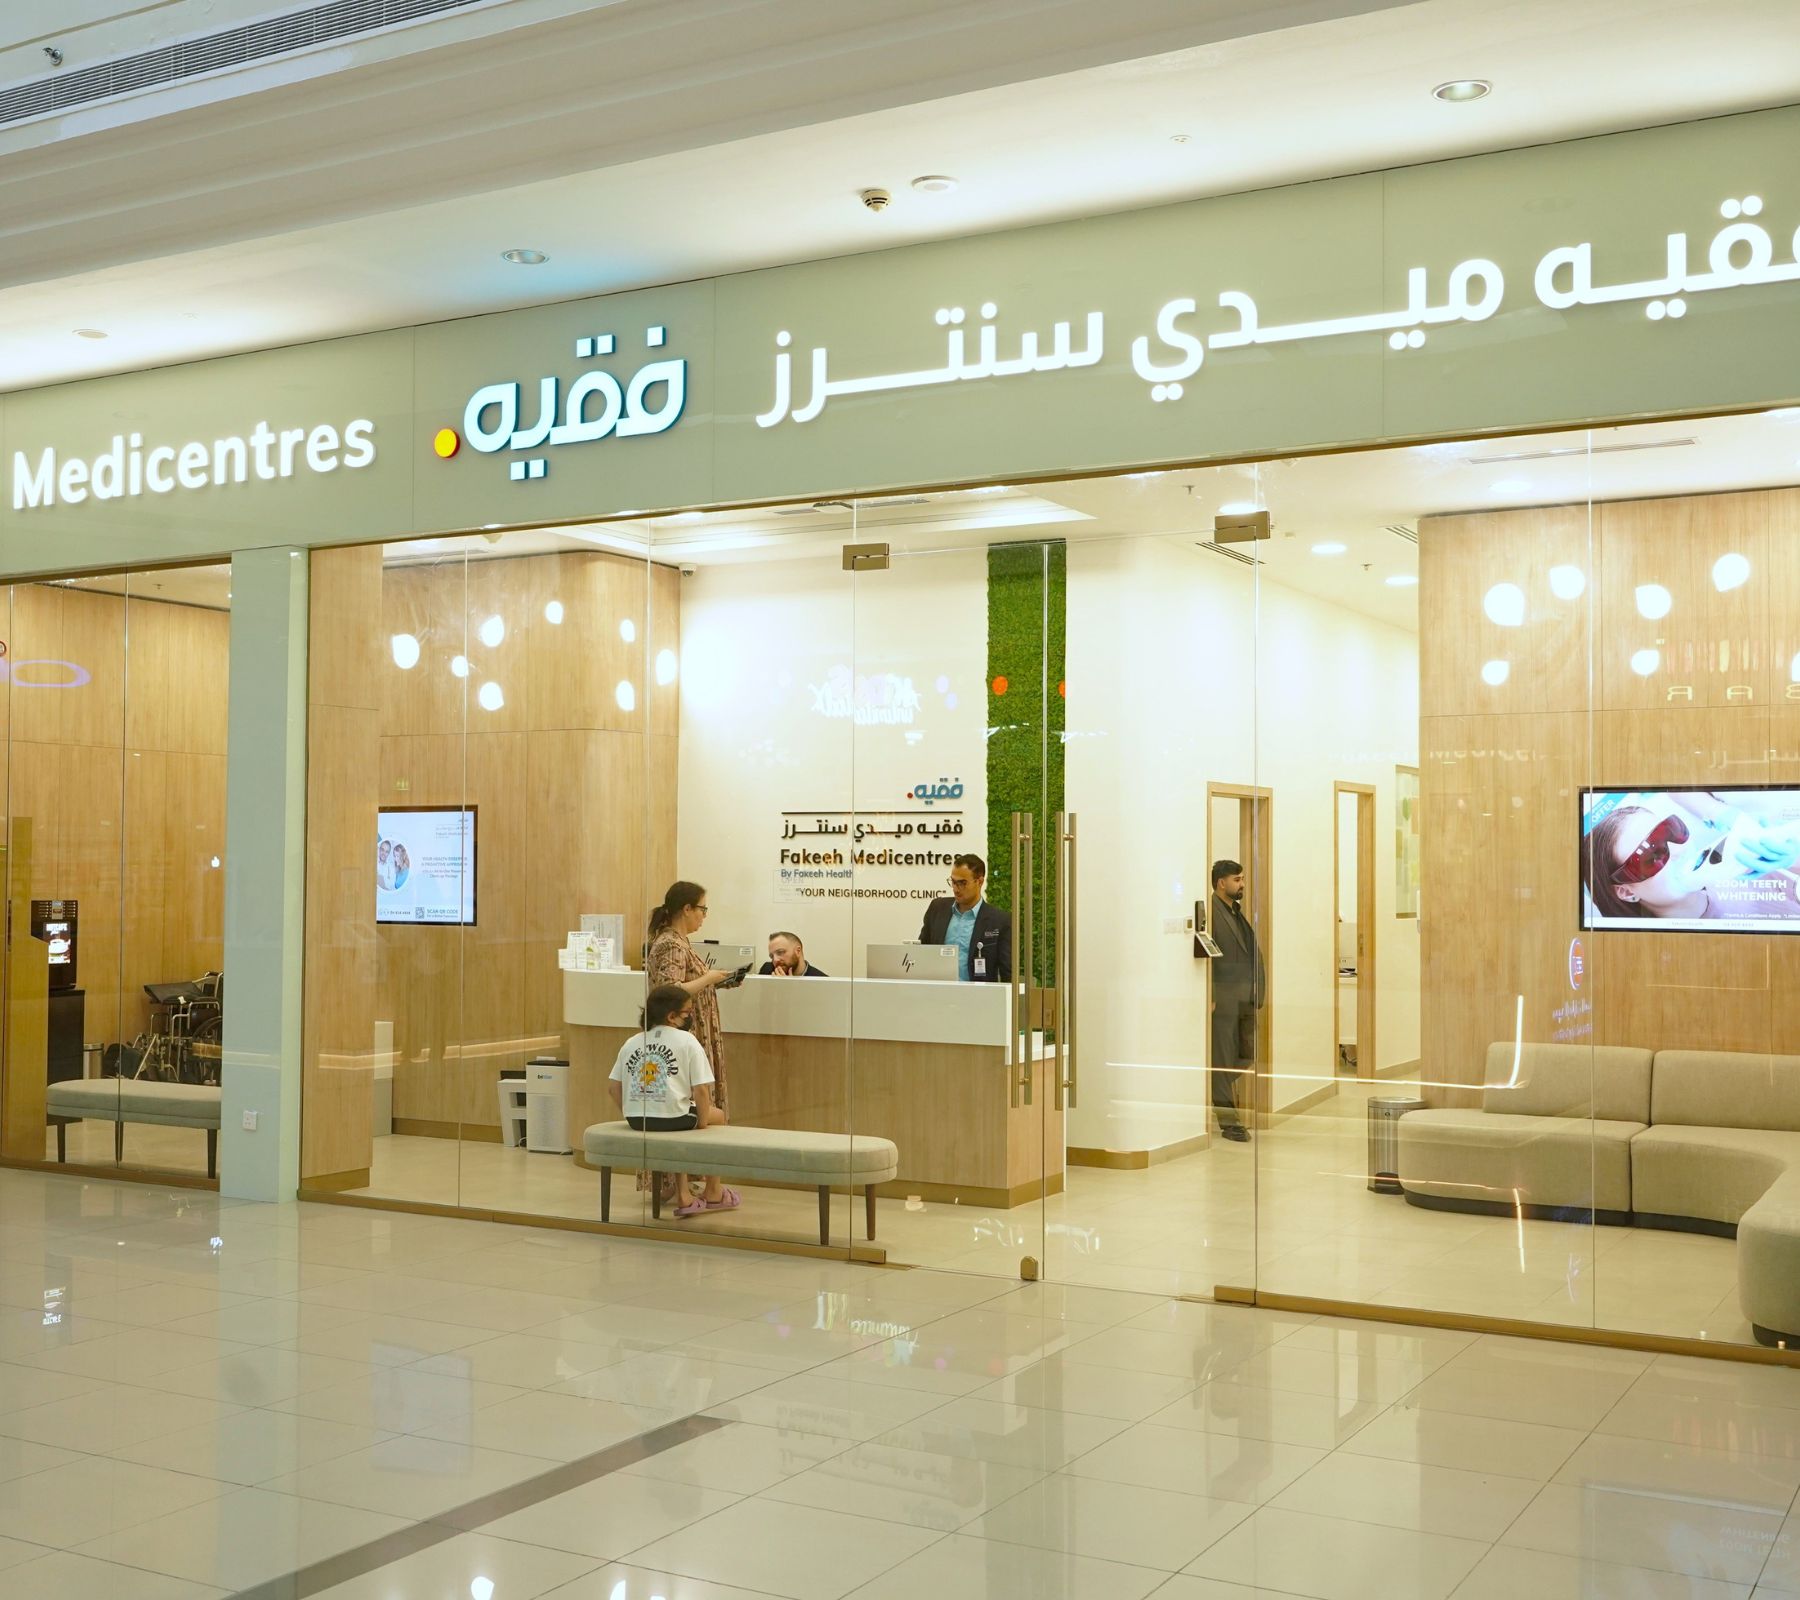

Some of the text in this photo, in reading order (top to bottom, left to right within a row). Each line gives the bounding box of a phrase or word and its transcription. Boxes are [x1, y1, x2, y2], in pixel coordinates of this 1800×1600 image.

[1534, 195, 1800, 320] قيه
[13, 418, 375, 509] Medicentres
[780, 848, 843, 865] Fakeeh
[781, 869, 791, 879] By
[794, 869, 823, 878] Fakeeh
[828, 888, 907, 898] NEIGHBORHOOD
[1752, 880, 1787, 889] TEETH
[1718, 892, 1786, 902] WHITENING
[902, 953, 914, 973] hp
[626, 1047, 643, 1073] THE
[645, 1043, 679, 1076] WORLD
